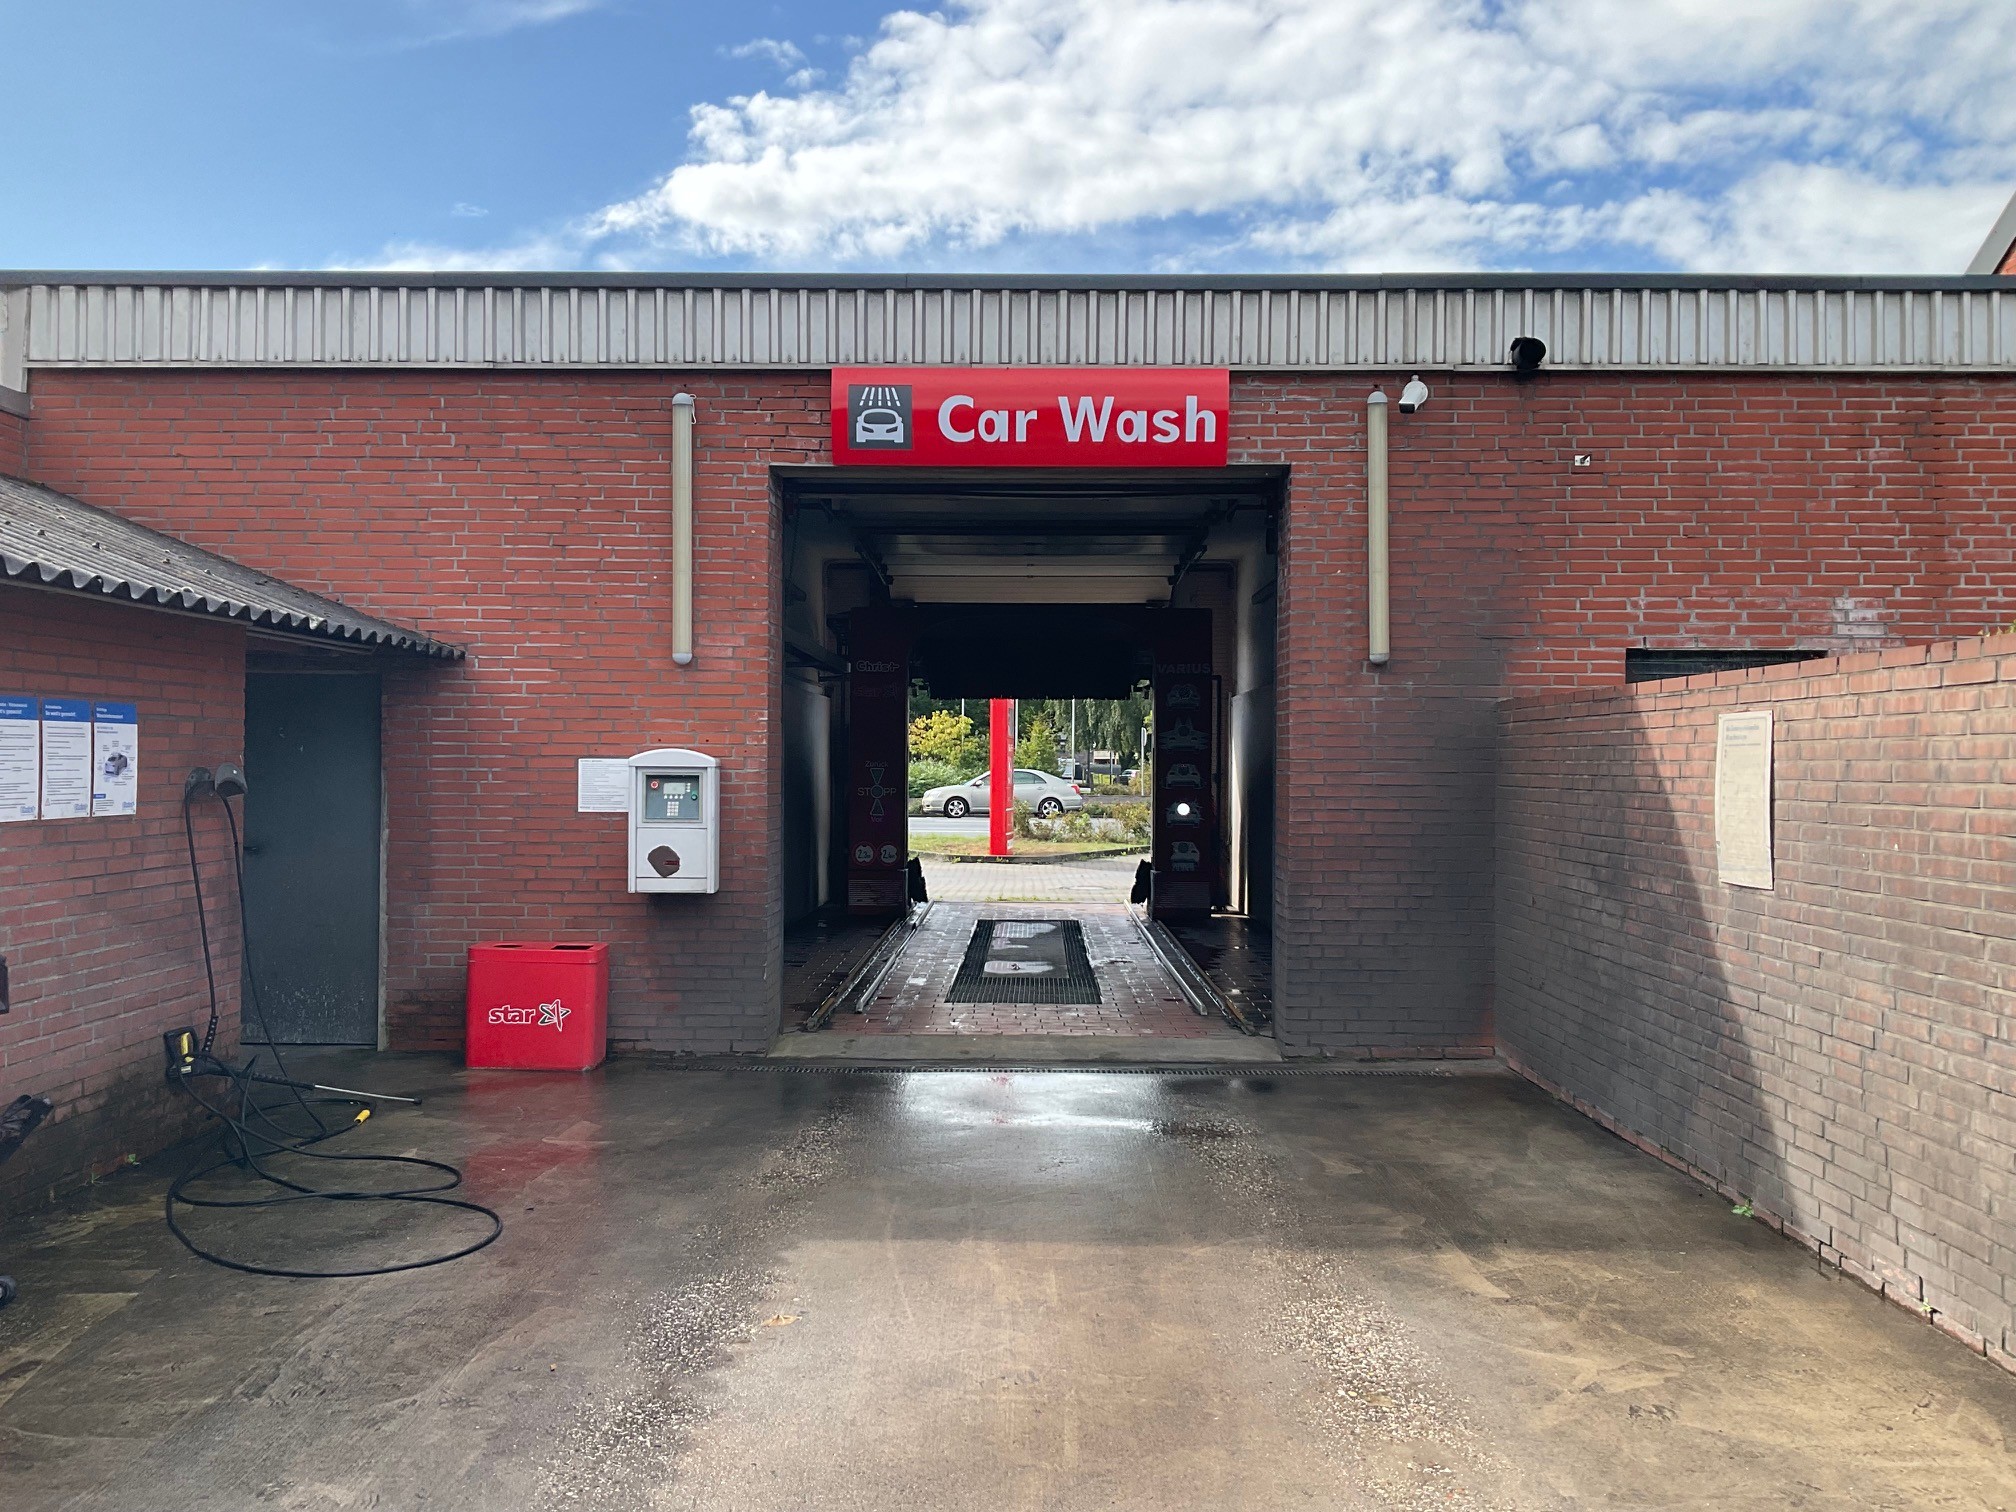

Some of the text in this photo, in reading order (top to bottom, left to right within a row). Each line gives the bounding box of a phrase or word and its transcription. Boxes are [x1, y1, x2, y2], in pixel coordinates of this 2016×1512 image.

[937, 394, 1217, 443] Car Wash
[1156, 662, 1211, 675] VARIUS
[488, 1004, 536, 1025] star
